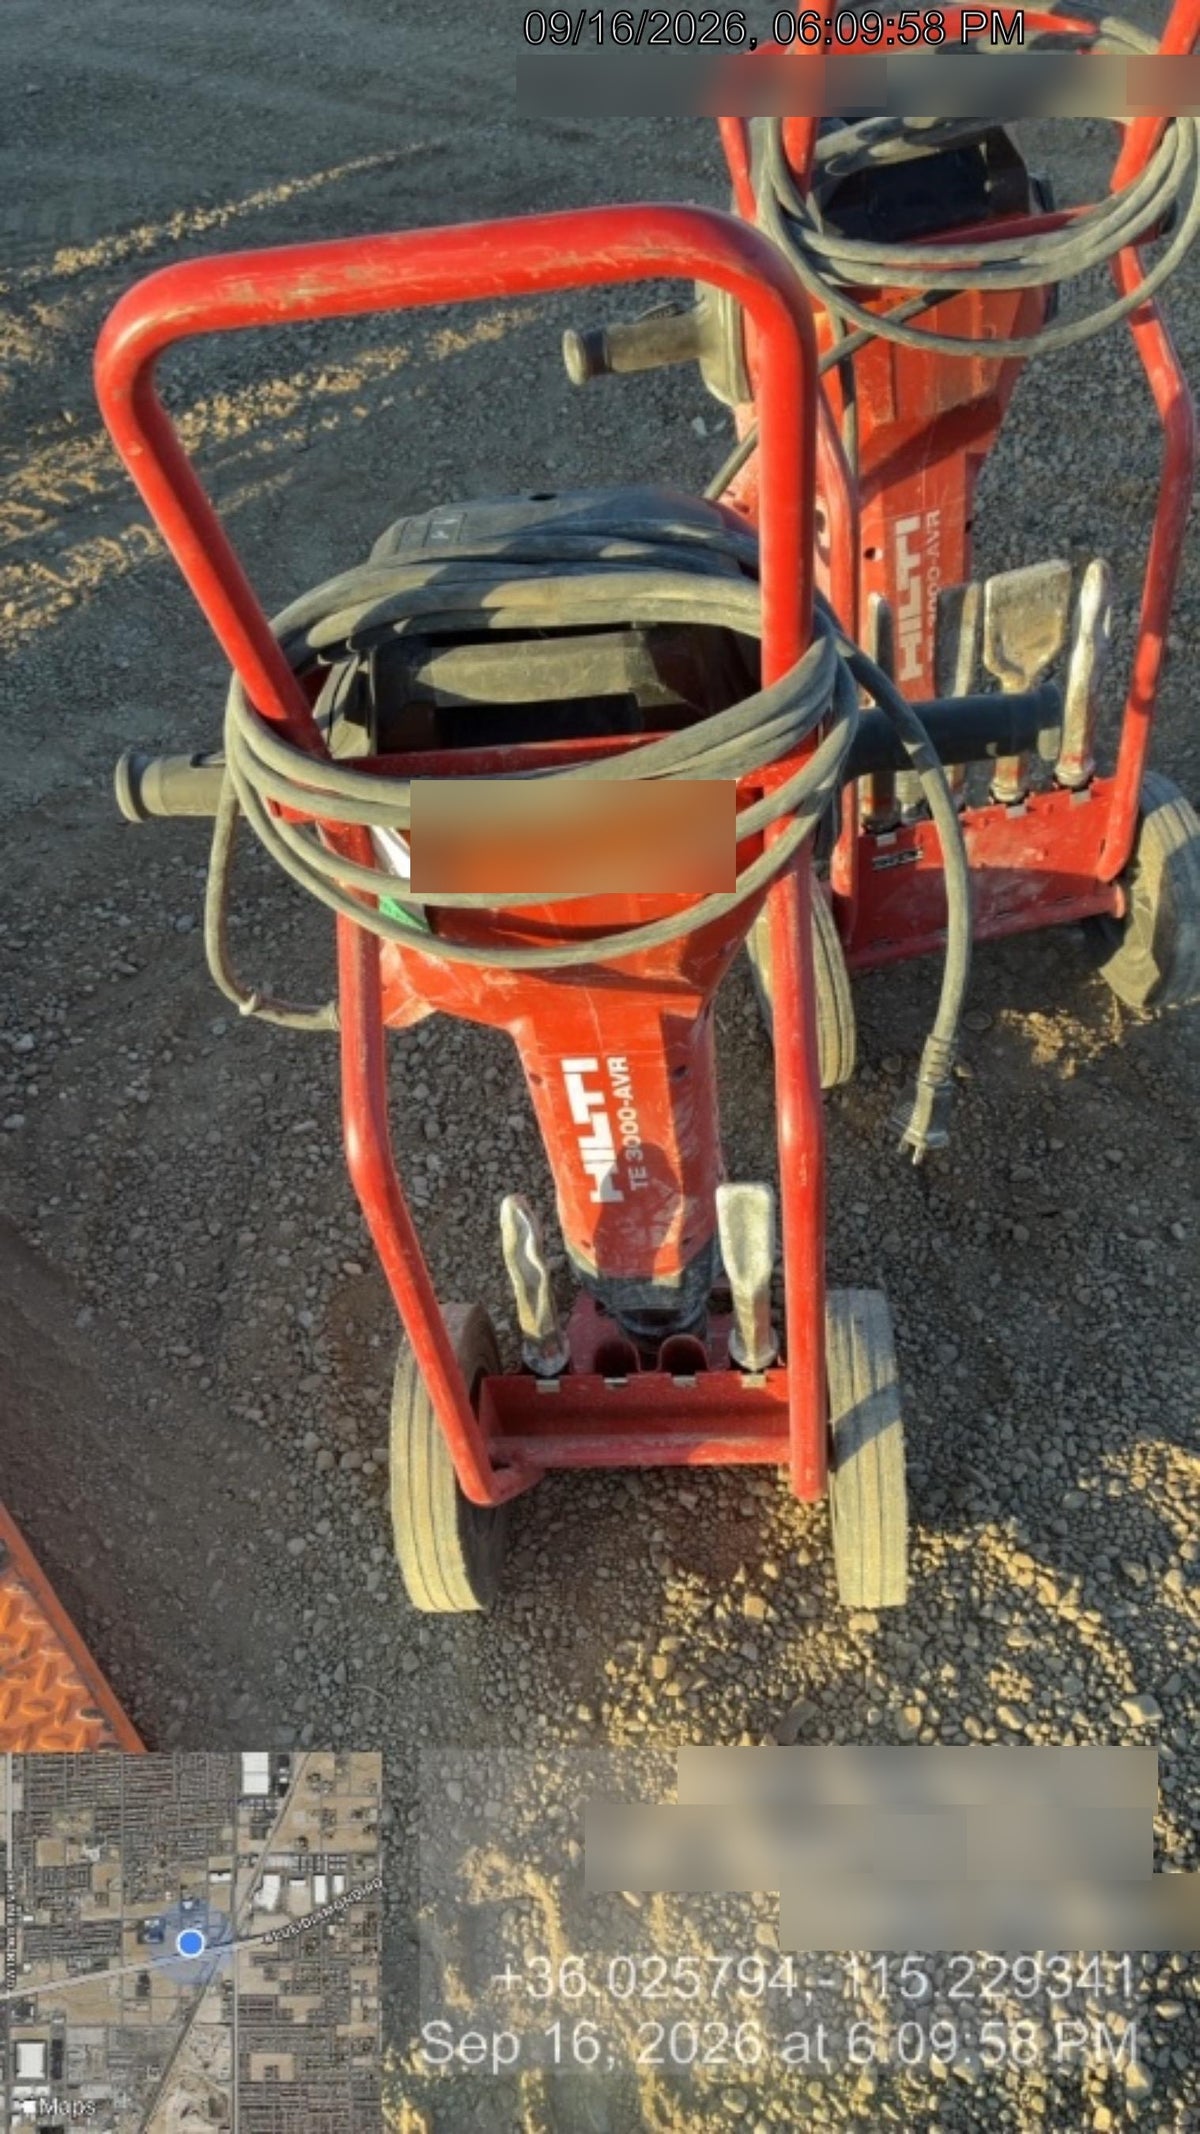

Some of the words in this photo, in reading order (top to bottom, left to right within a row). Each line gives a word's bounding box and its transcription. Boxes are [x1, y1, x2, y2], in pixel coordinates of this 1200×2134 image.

[895, 515, 924, 682] HILTI
[560, 1056, 625, 1203] HILTI
[606, 1055, 644, 1162] 3000-AVR
[627, 1165, 649, 1191] TE
